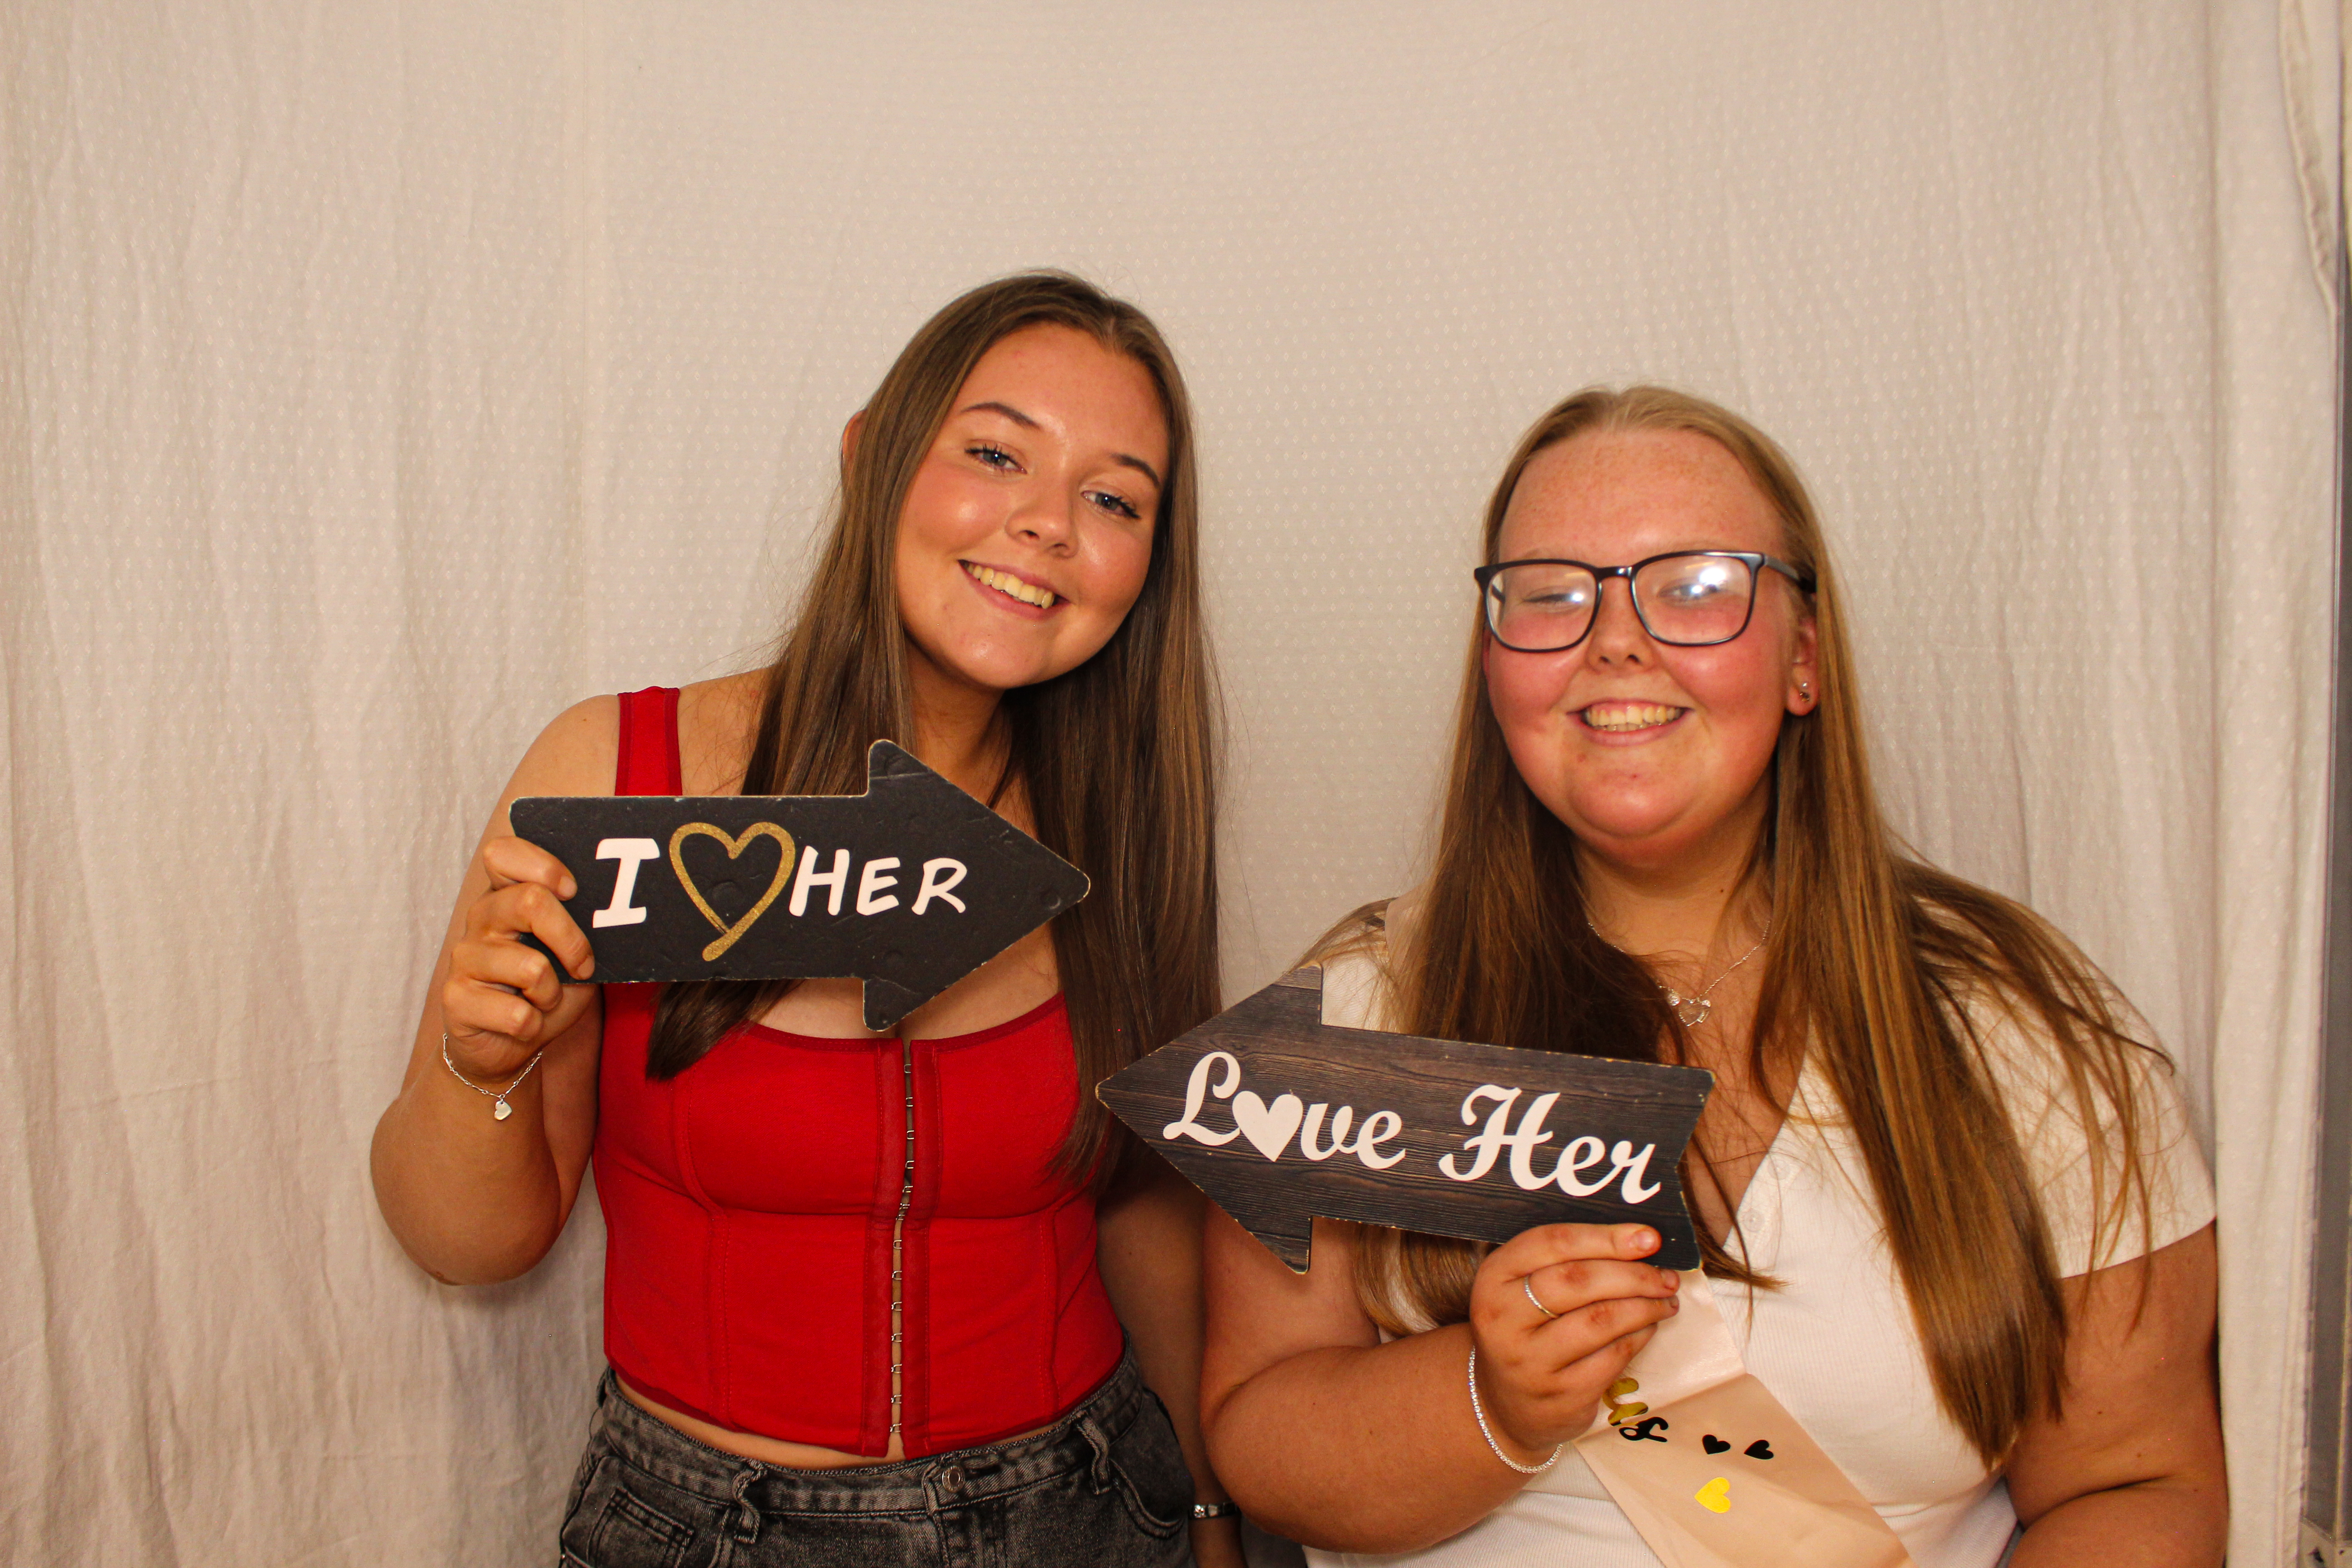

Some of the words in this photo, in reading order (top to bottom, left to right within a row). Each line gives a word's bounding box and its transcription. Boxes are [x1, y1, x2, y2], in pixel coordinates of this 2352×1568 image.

[593, 838, 661, 929] I
[789, 845, 967, 917] HER
[1437, 1083, 1661, 1205] Her
